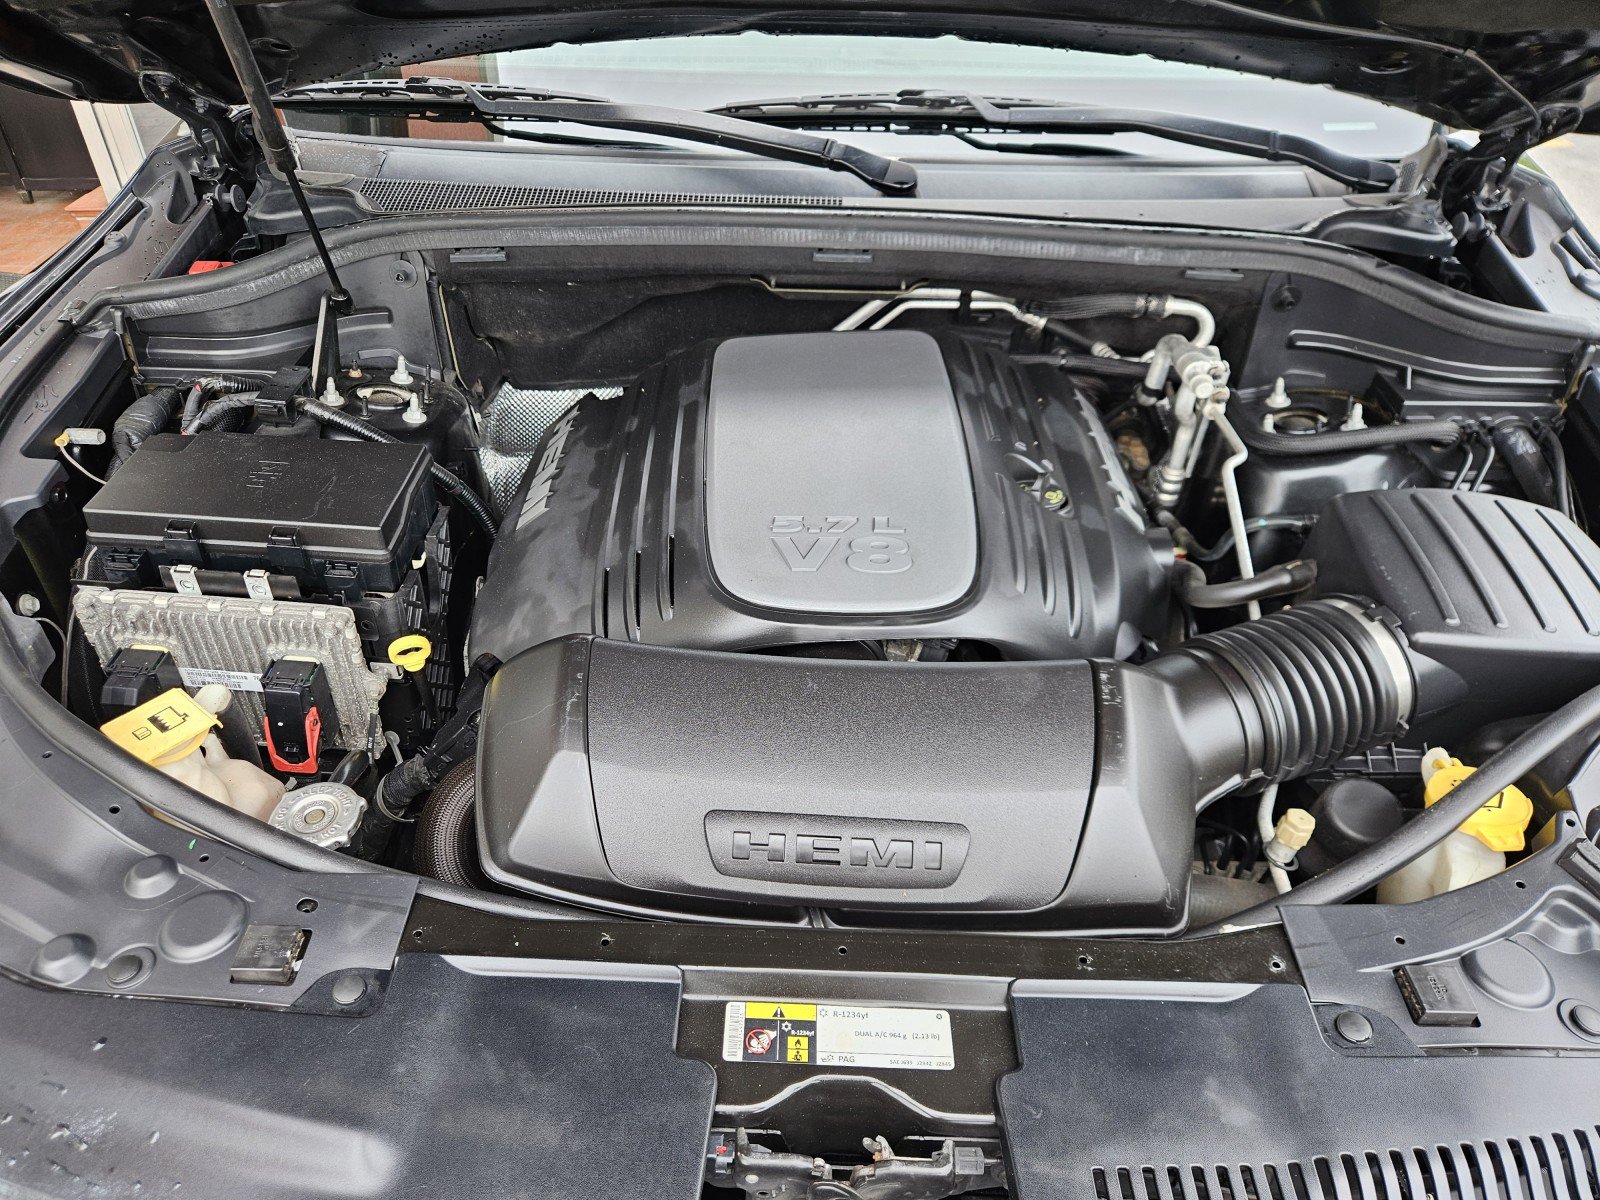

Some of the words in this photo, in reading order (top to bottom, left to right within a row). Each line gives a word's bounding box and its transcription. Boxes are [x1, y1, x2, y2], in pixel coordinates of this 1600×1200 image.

[770, 515, 859, 534] 5.7
[872, 515, 906, 534] L
[769, 536, 913, 574] V8
[732, 831, 943, 871] HEMI
[833, 1010, 869, 1021] R-1234yf
[791, 1029, 815, 1037] R-1234yf
[854, 1030, 873, 1038] DUAL
[874, 1031, 888, 1039] A/C
[838, 1055, 855, 1063] PAG
